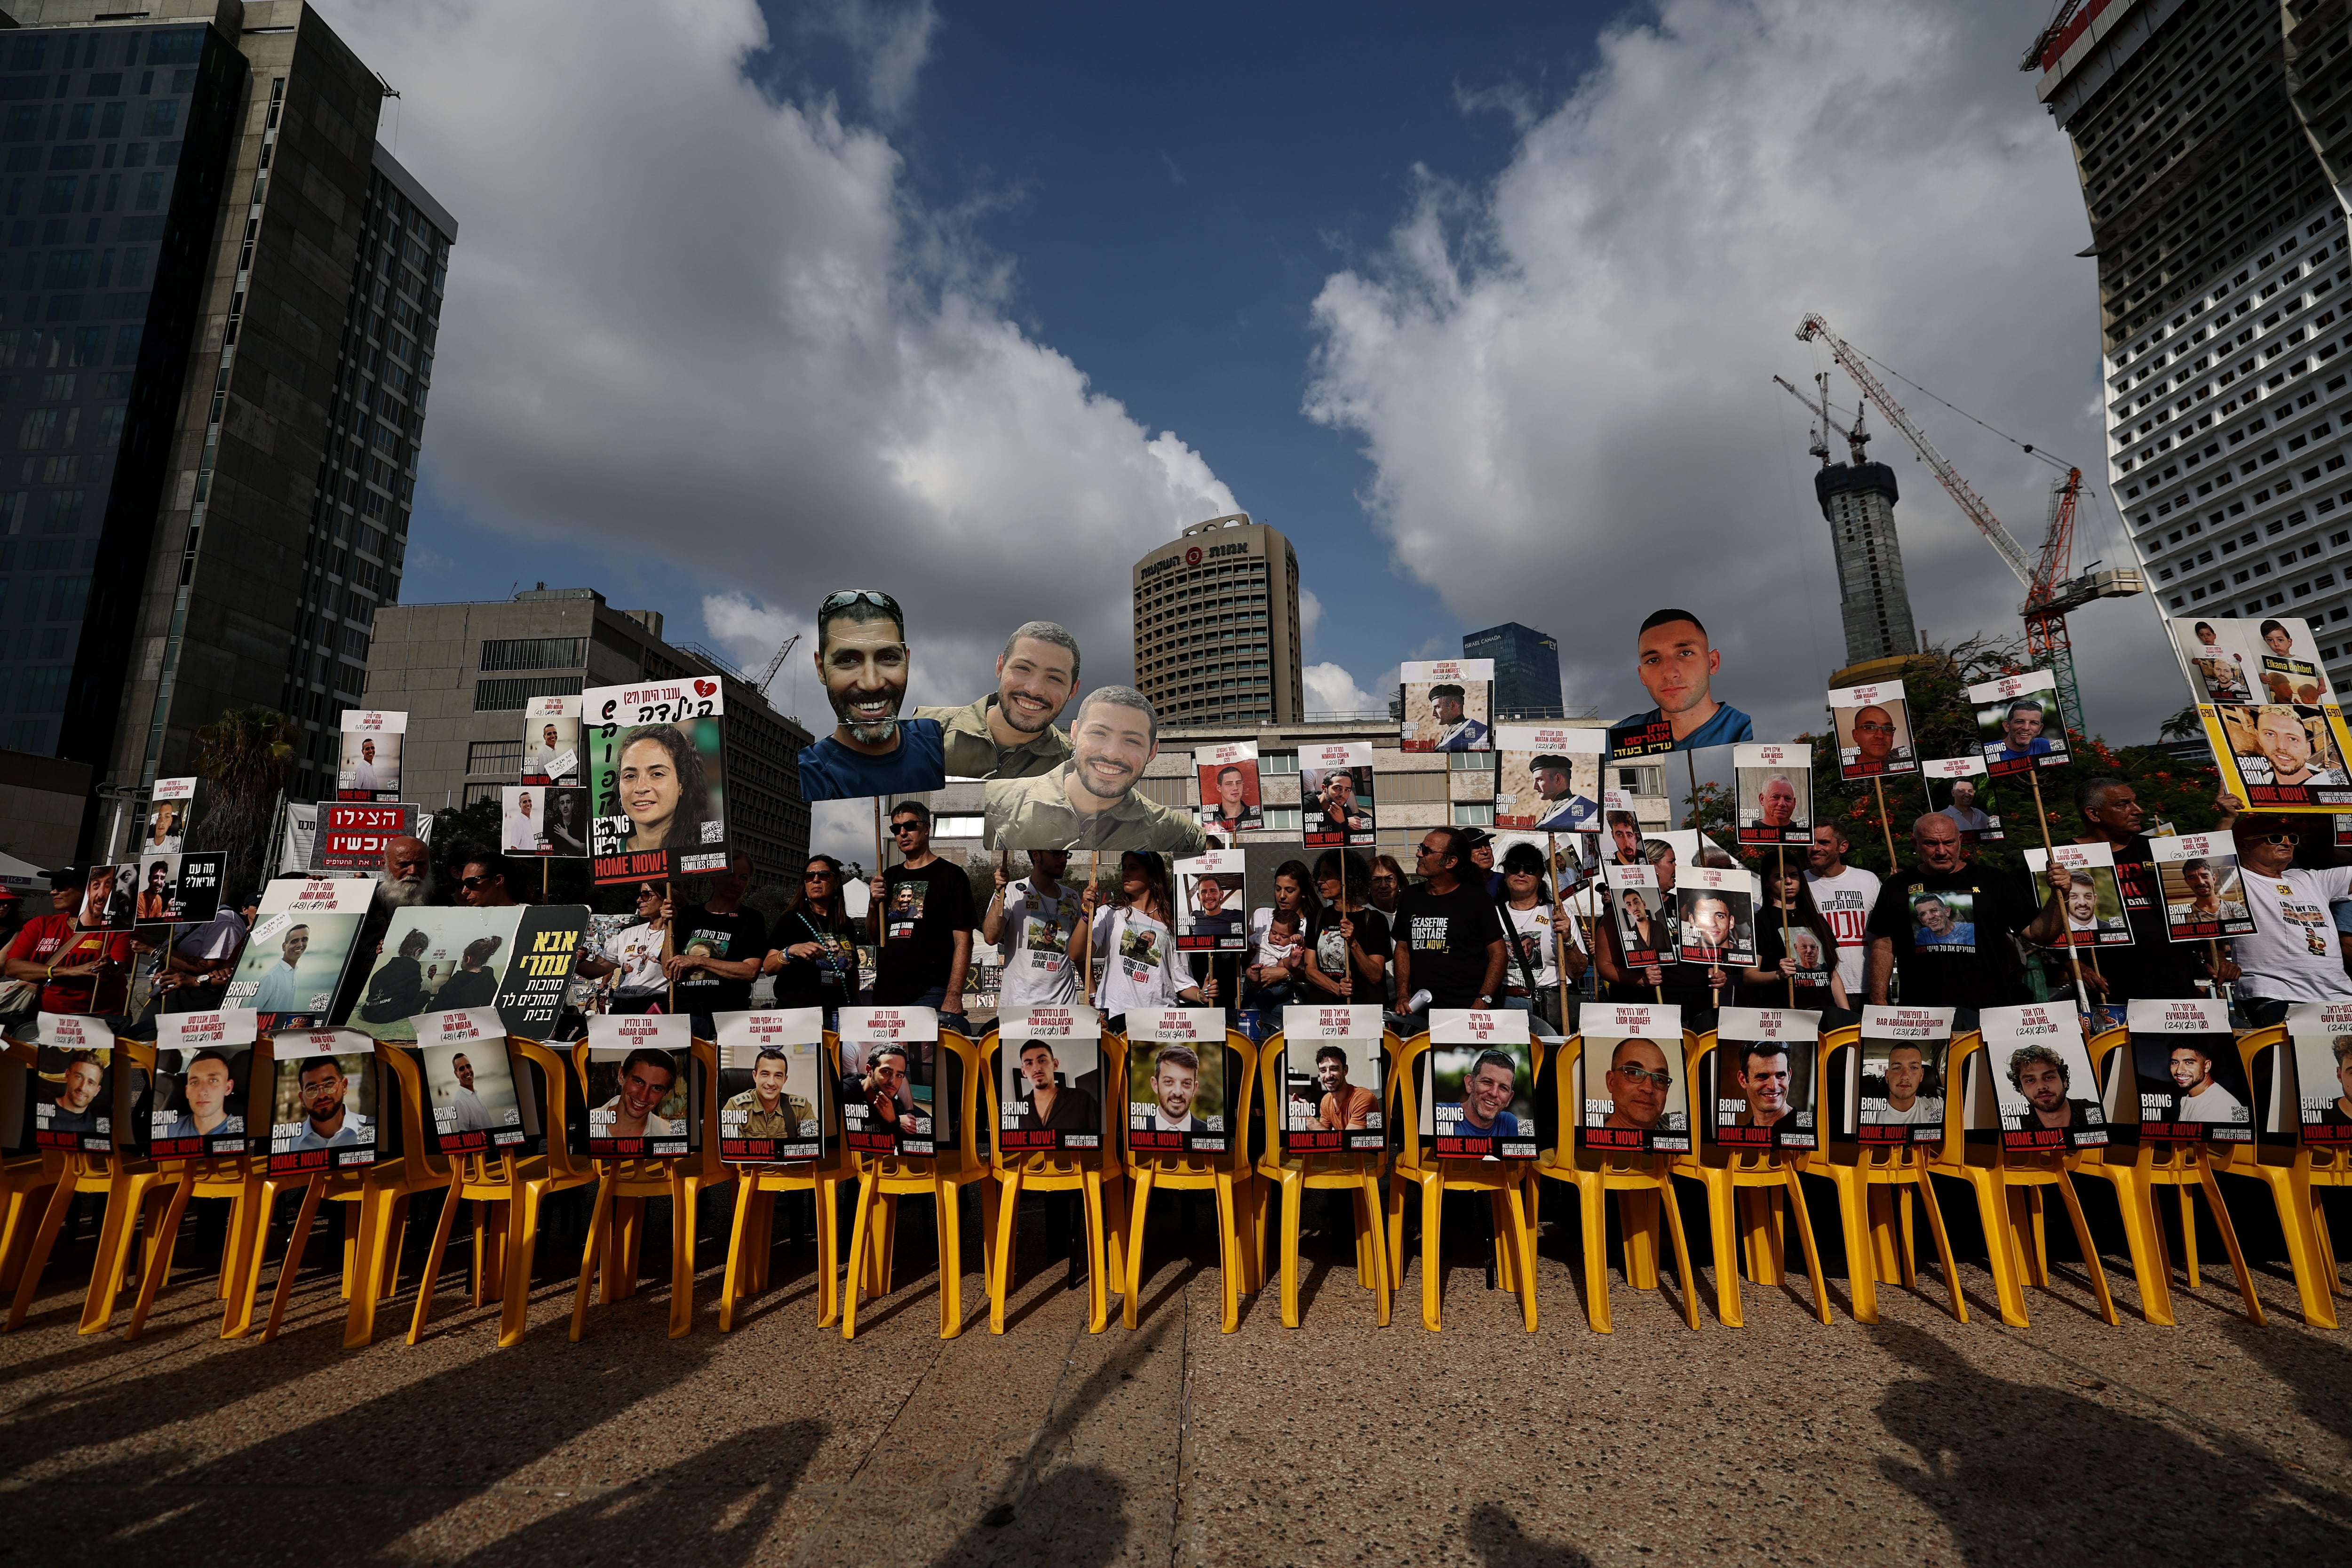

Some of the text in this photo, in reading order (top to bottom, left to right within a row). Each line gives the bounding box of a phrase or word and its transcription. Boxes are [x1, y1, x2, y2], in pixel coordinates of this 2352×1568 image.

[1141, 542, 1248, 580] אמות השקעות
[1465, 634, 1501, 649] ISRAEL CANADA
[1549, 640, 1557, 651] EY
[2266, 659, 2312, 674] Elkana Bohbot
[2007, 683, 2022, 692] CHAIMI
[624, 687, 680, 705] ענבר הימן (27)
[2202, 708, 2215, 718] 690
[2327, 708, 2341, 717] 690
[1646, 721, 1669, 734] מתן
[1624, 732, 1670, 745] אנגרסט
[1614, 745, 1642, 757] בעזה
[2238, 756, 2270, 770] BRING
[2244, 770, 2265, 785] HIM
[2249, 785, 2309, 801] HOME NOW!
[336, 811, 397, 826] הצילו
[595, 850, 668, 877] HOME NOW!
[681, 859, 726, 872] FAMILIES FORUM
[185, 876, 215, 888] אריאל?
[1909, 884, 1923, 893] 690
[1835, 891, 1862, 900] מחזירים
[1025, 901, 1039, 910] 690
[1821, 900, 1864, 911] אותם הביתה
[1412, 917, 1449, 928] CEASEFIRE
[1535, 915, 1549, 925] 690
[1412, 927, 1446, 940] HOSTAGE
[532, 930, 579, 952] אבא
[1412, 939, 1446, 950] DEAL NOW!
[1033, 952, 1058, 962] BRING ITAY
[520, 954, 572, 976] עמרי
[1032, 960, 1059, 971] HOME NOW!
[226, 981, 260, 997] BRING
[525, 979, 564, 991] מחכות
[501, 992, 559, 1009] ומחכים לך
[523, 1008, 553, 1021] בבית
[443, 1020, 472, 1032] OMRI MIRAN
[625, 1019, 652, 1027] הדר גולדין
[1876, 1018, 1888, 1026] BAR
[1889, 1019, 1915, 1027] ABRAHAM
[2022, 1016, 2050, 1026] ALON OHEL
[182, 1022, 226, 1034] MATAN ANGREST
[1629, 1026, 1639, 1035] (61)
[1765, 1028, 1776, 1037] (48)
[311, 1035, 322, 1043] RAN
[632, 1036, 643, 1045] (23)
[760, 1035, 771, 1043] (40)
[1476, 1031, 1487, 1040] (42)
[1586, 1099, 1614, 1114] BRING
[1719, 1098, 1746, 1112] BRING
[589, 1110, 617, 1124] BRING
[1436, 1106, 1464, 1122] BRING
[1719, 1113, 1736, 1125] HIM
[1586, 1114, 1604, 1128] HIM
[589, 1124, 607, 1138] HIM
[1436, 1122, 1454, 1136] HIM
[1718, 1127, 1772, 1142] HOME NOW!
[1586, 1129, 1643, 1146] HOME NOW!
[1437, 1137, 1493, 1154] HOME NOW!
